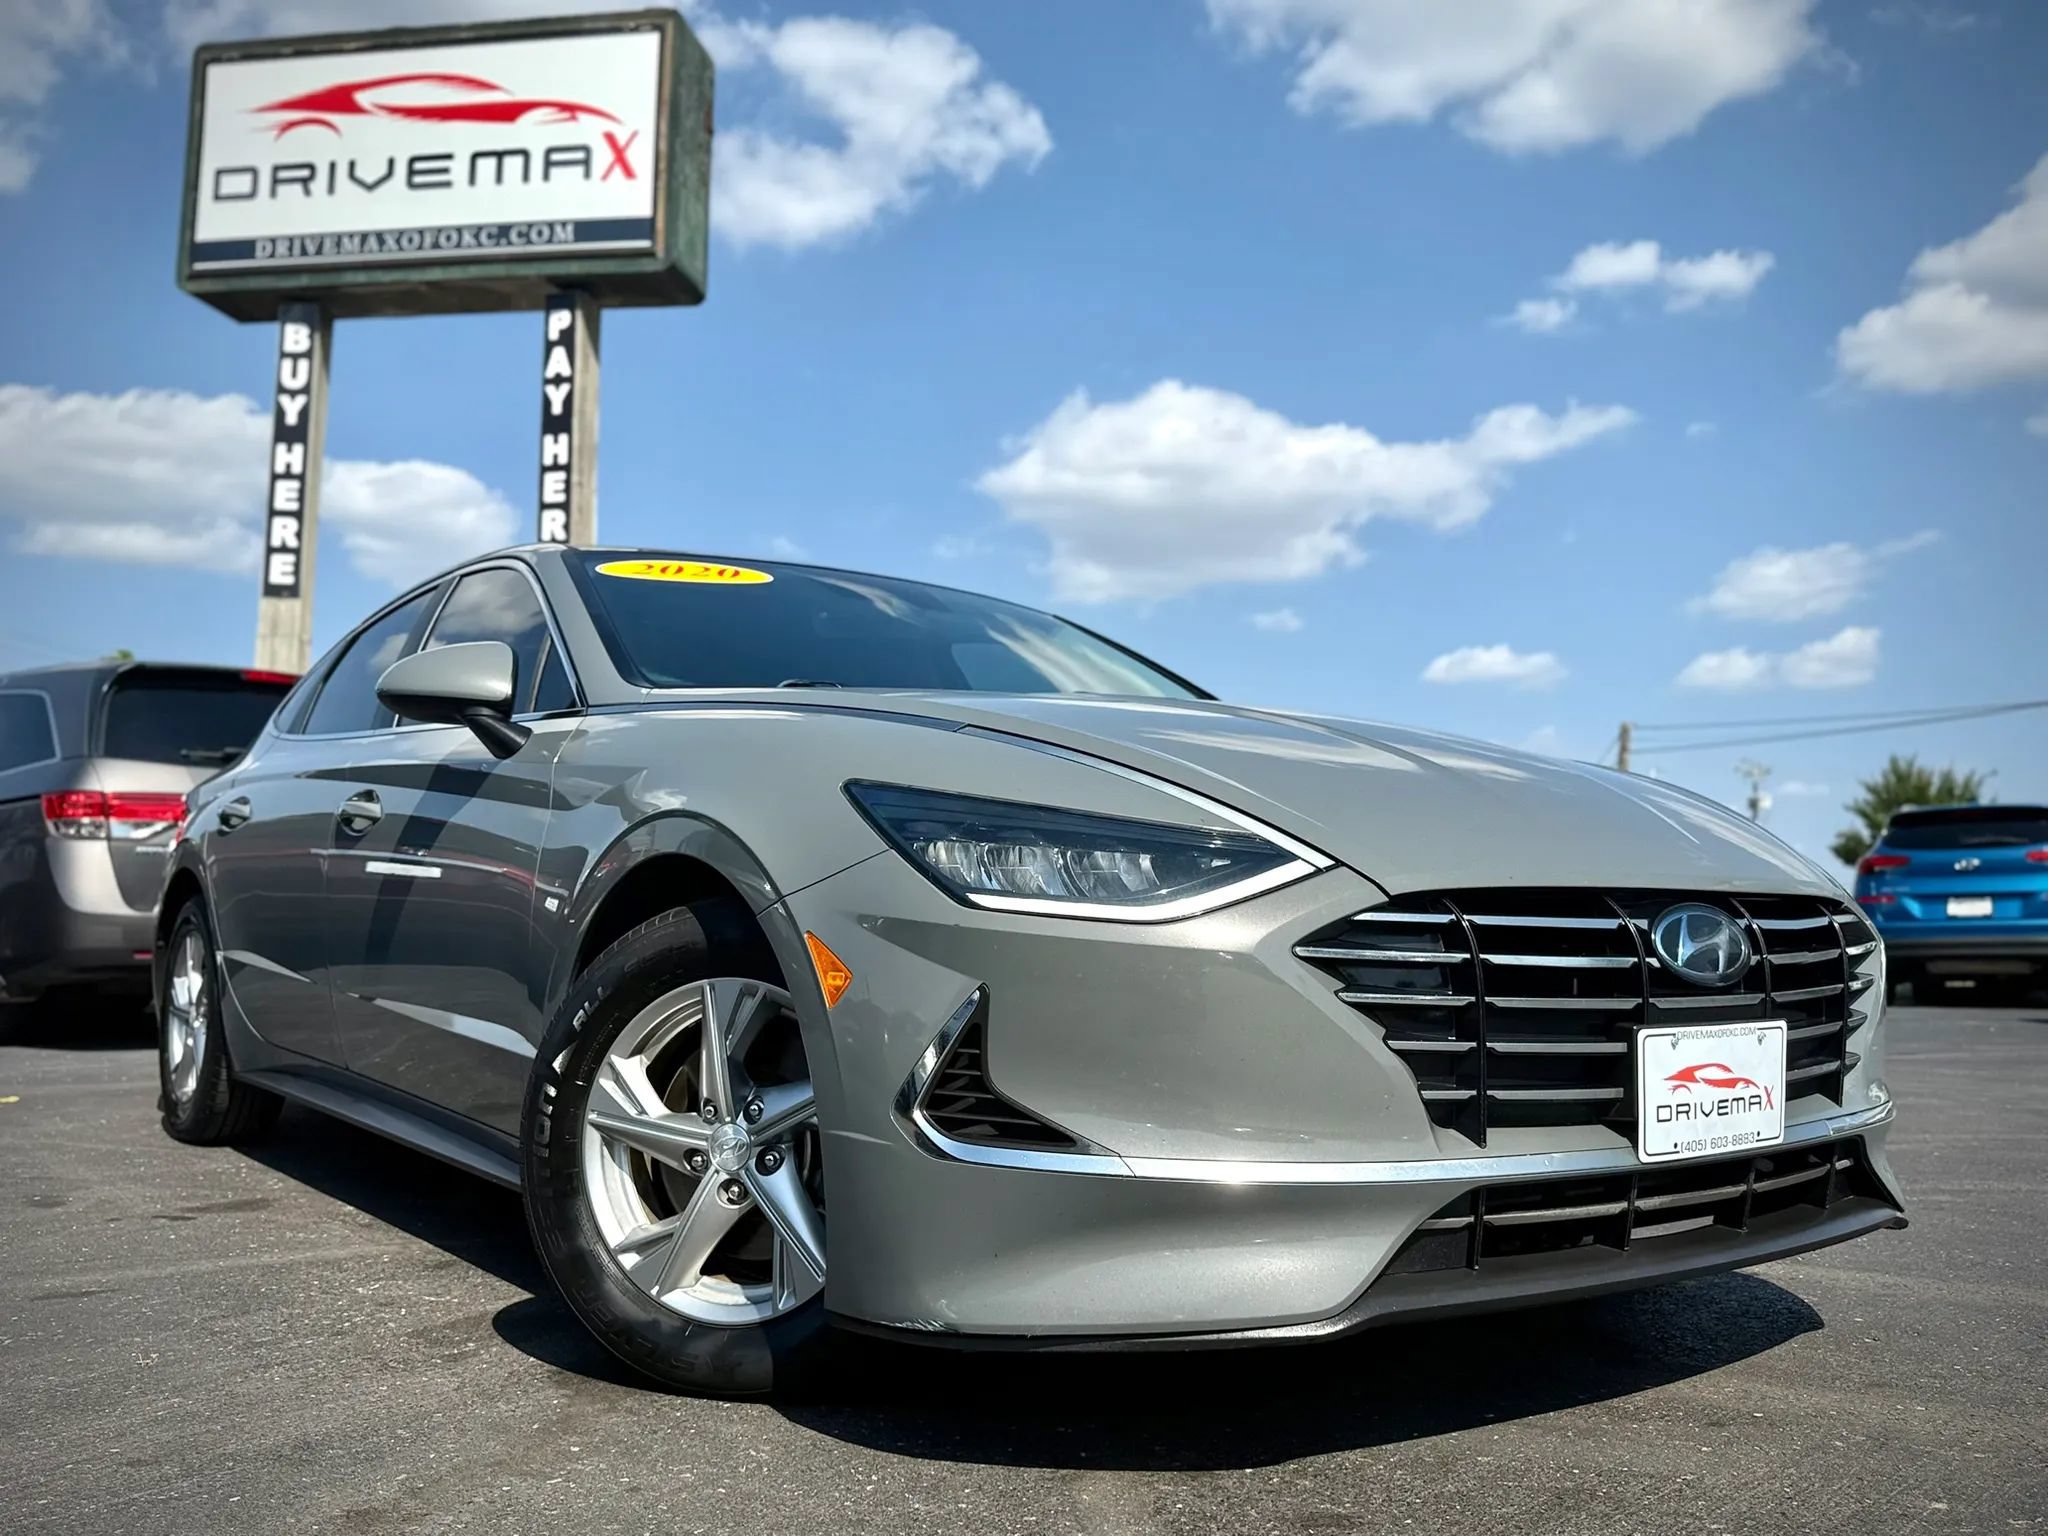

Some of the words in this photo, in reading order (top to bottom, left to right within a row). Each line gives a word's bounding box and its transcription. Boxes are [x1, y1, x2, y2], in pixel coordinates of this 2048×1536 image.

[212, 130, 639, 202] DRIVEMAX
[254, 222, 575, 260] DRIVEMAXOFOKC.COM
[278, 322, 311, 426] BUY
[544, 309, 572, 415] PAY
[268, 443, 305, 586] HERE
[632, 563, 741, 578] 2020
[1656, 1085, 1774, 1123] DRIVEMAX
[1680, 1138, 1707, 1154] (405)
